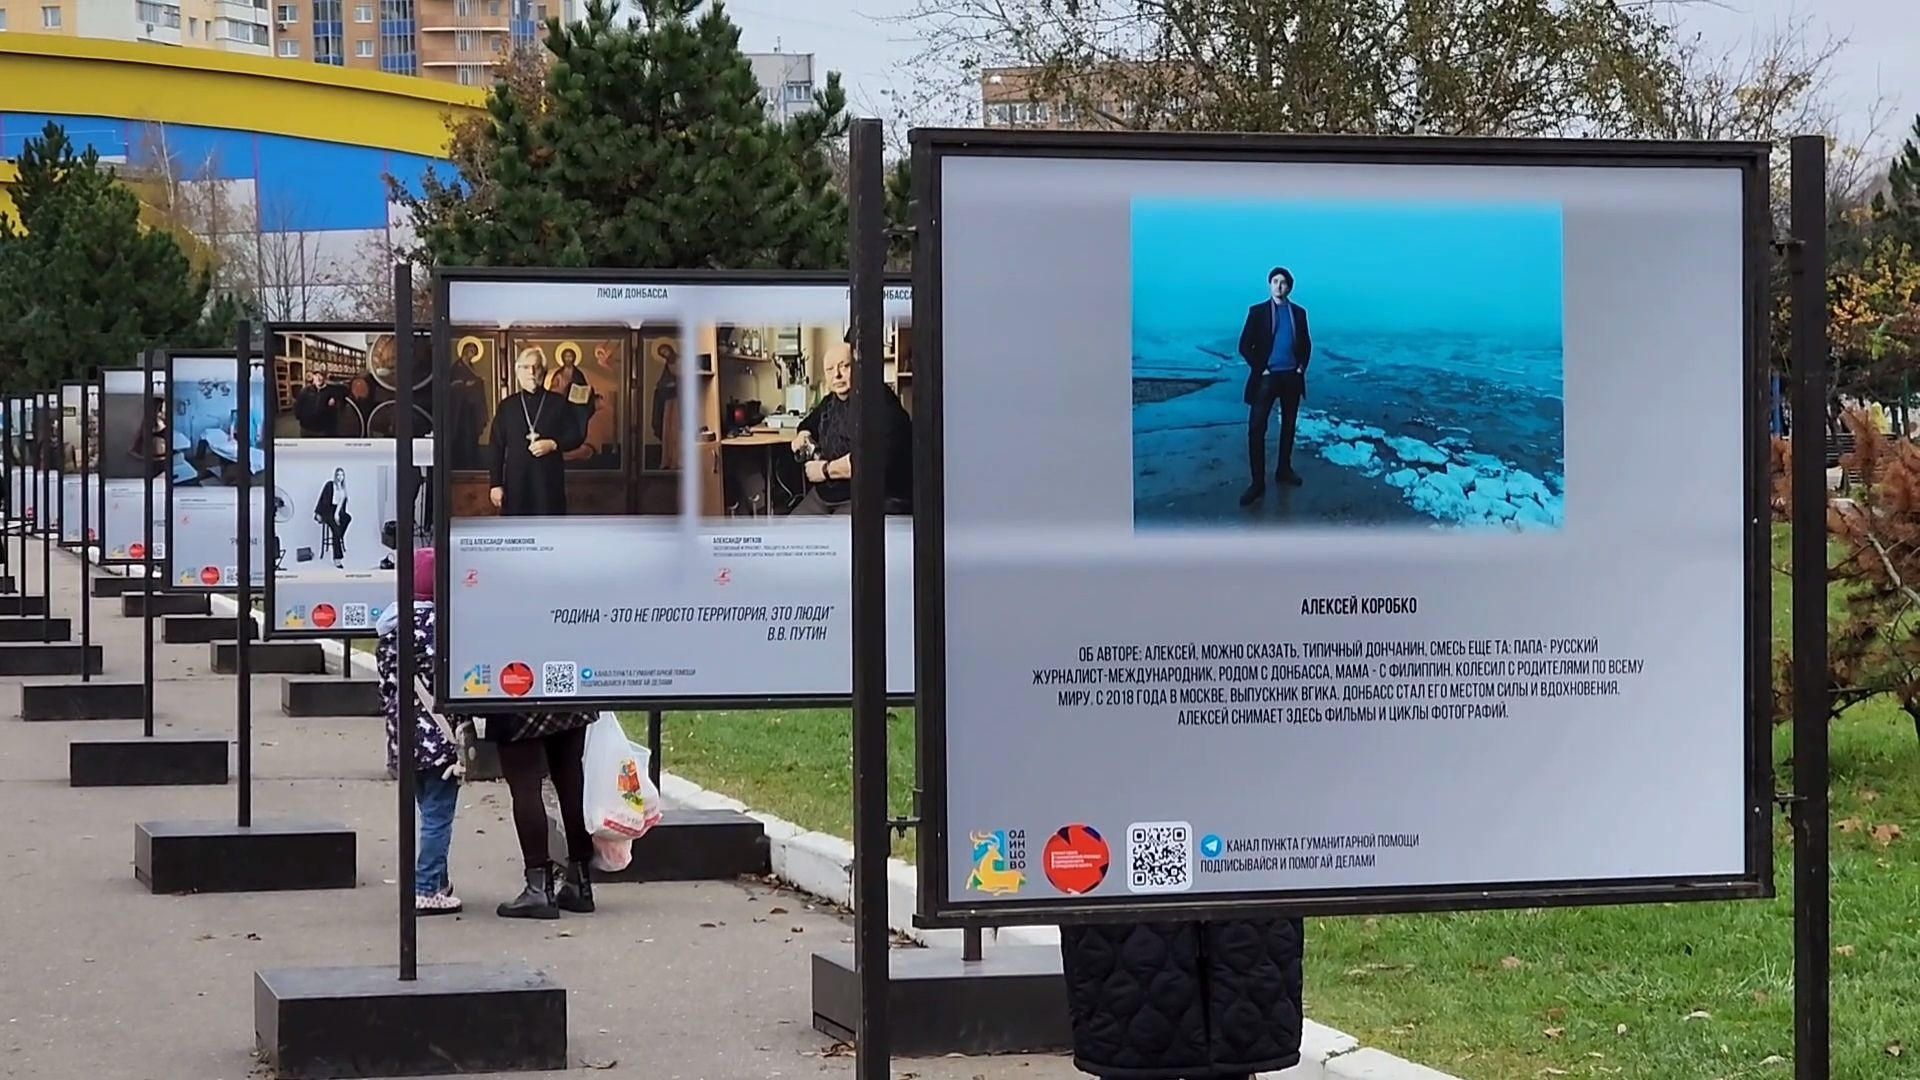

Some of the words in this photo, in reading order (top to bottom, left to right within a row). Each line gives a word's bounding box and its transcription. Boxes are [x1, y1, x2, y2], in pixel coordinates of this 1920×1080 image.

[597, 287, 623, 300] ЛЮДИ
[625, 287, 668, 299] ДОНБАССА
[611, 608, 633, 623] ЭТО
[634, 608, 650, 622] НЕ
[651, 607, 694, 622] ПРОСТО
[698, 606, 768, 622] ТЕРРИТОРИЯ,
[771, 606, 793, 621] ЭТО
[1301, 595, 1358, 616] АЛЕКСЕЙ
[1361, 597, 1417, 615] КОРОБКО
[767, 626, 786, 641] В.В.
[789, 626, 827, 641] ПУТИН
[1079, 647, 1094, 662] ОБ
[1096, 646, 1142, 661] АВТОРЕ:
[1201, 644, 1244, 659] МОЖНО
[1303, 640, 1363, 657] ТИПИЧНЫЙ
[1430, 641, 1466, 656] СМЕСЬ
[1469, 640, 1492, 656] ЕЩЕ
[1495, 640, 1512, 654] ТА:
[1550, 636, 1599, 654] РУССКИЙ
[1219, 665, 1258, 682] РОДОМ
[1261, 665, 1268, 681] С
[1271, 664, 1333, 682] ДОНБАССА,
[1336, 663, 1369, 678] МАМА
[1380, 663, 1387, 678] С
[1456, 661, 1506, 677] КОЛЕСИЛ
[1508, 661, 1515, 676] С
[1517, 660, 1590, 677] РОДИТЕЛЯМИ
[1592, 659, 1606, 674] ПО
[1608, 659, 1644, 674] ВСЕМУ
[1096, 690, 1104, 705] С
[1106, 689, 1134, 705] 2018
[1137, 689, 1167, 705] ГОДА
[1170, 688, 1178, 704] В
[1230, 686, 1299, 703] ВЫПУСКНИК
[1343, 684, 1394, 702] ДОНБАСС
[1396, 684, 1426, 699] СТАЛ
[1428, 683, 1448, 698] ЕГО
[1450, 682, 1495, 698] МЕСТОМ
[1497, 682, 1529, 697] СИЛЫ
[1531, 682, 1538, 696] И
[1540, 680, 1621, 698] ВДОХНОВЕНИЯ.
[1178, 706, 1229, 725] АЛЕКСЕЙ
[1231, 708, 1284, 724] СНИМАЕТ
[1286, 707, 1322, 724] ЗДЕСЬ
[1325, 706, 1377, 722] ФИЛЬМЫ
[1379, 706, 1387, 721] И
[1389, 705, 1429, 722] ЦИКЛЫ
[1431, 701, 1509, 720] ФОТОГРАФИЙ.
[1226, 839, 1260, 852] КАНАЛ
[1261, 837, 1299, 851] ПУНКТА
[1301, 833, 1376, 850] ГУМАНИТАРНОЙ
[1378, 833, 1419, 848] ПОМОЩИ
[1200, 855, 1278, 873] ПОДПИСЫВАЙСЯ
[1280, 857, 1287, 870] И
[1289, 853, 1333, 870] ПОМОГАЙ
[1335, 854, 1376, 869] ДЕЛАМИ
